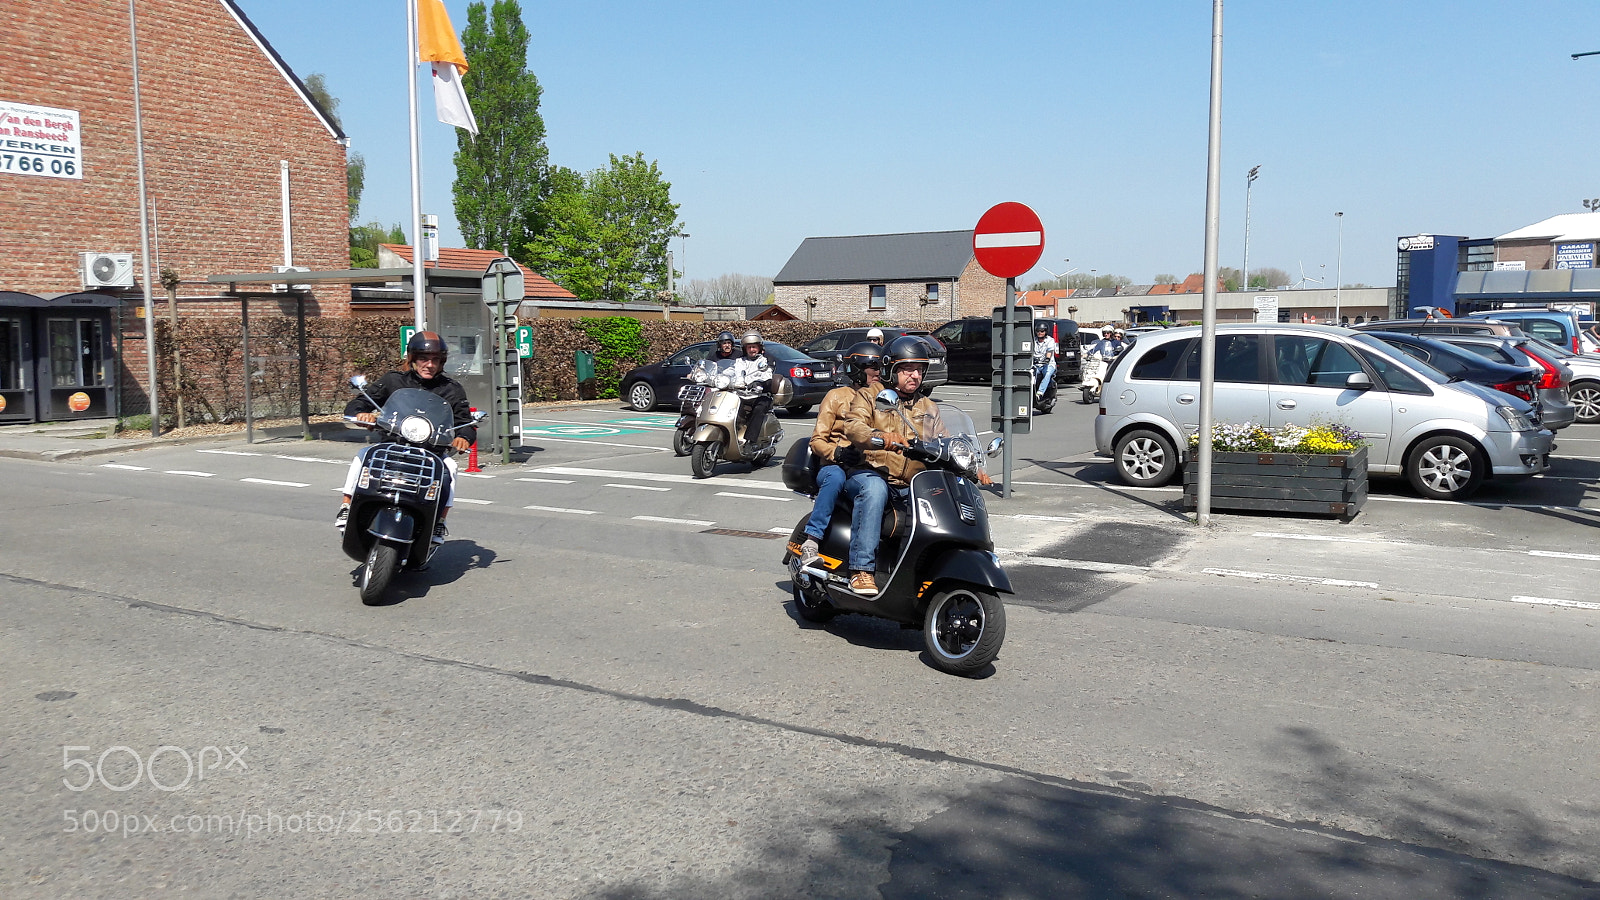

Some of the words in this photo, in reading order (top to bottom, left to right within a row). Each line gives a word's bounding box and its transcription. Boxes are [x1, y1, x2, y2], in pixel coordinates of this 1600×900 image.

[23, 116, 41, 126] den
[45, 119, 74, 131] Bergh
[13, 127, 68, 141] Ransbeeck
[0, 140, 75, 154] ERKEN
[51, 159, 75, 175] 06
[520, 328, 529, 343] P
